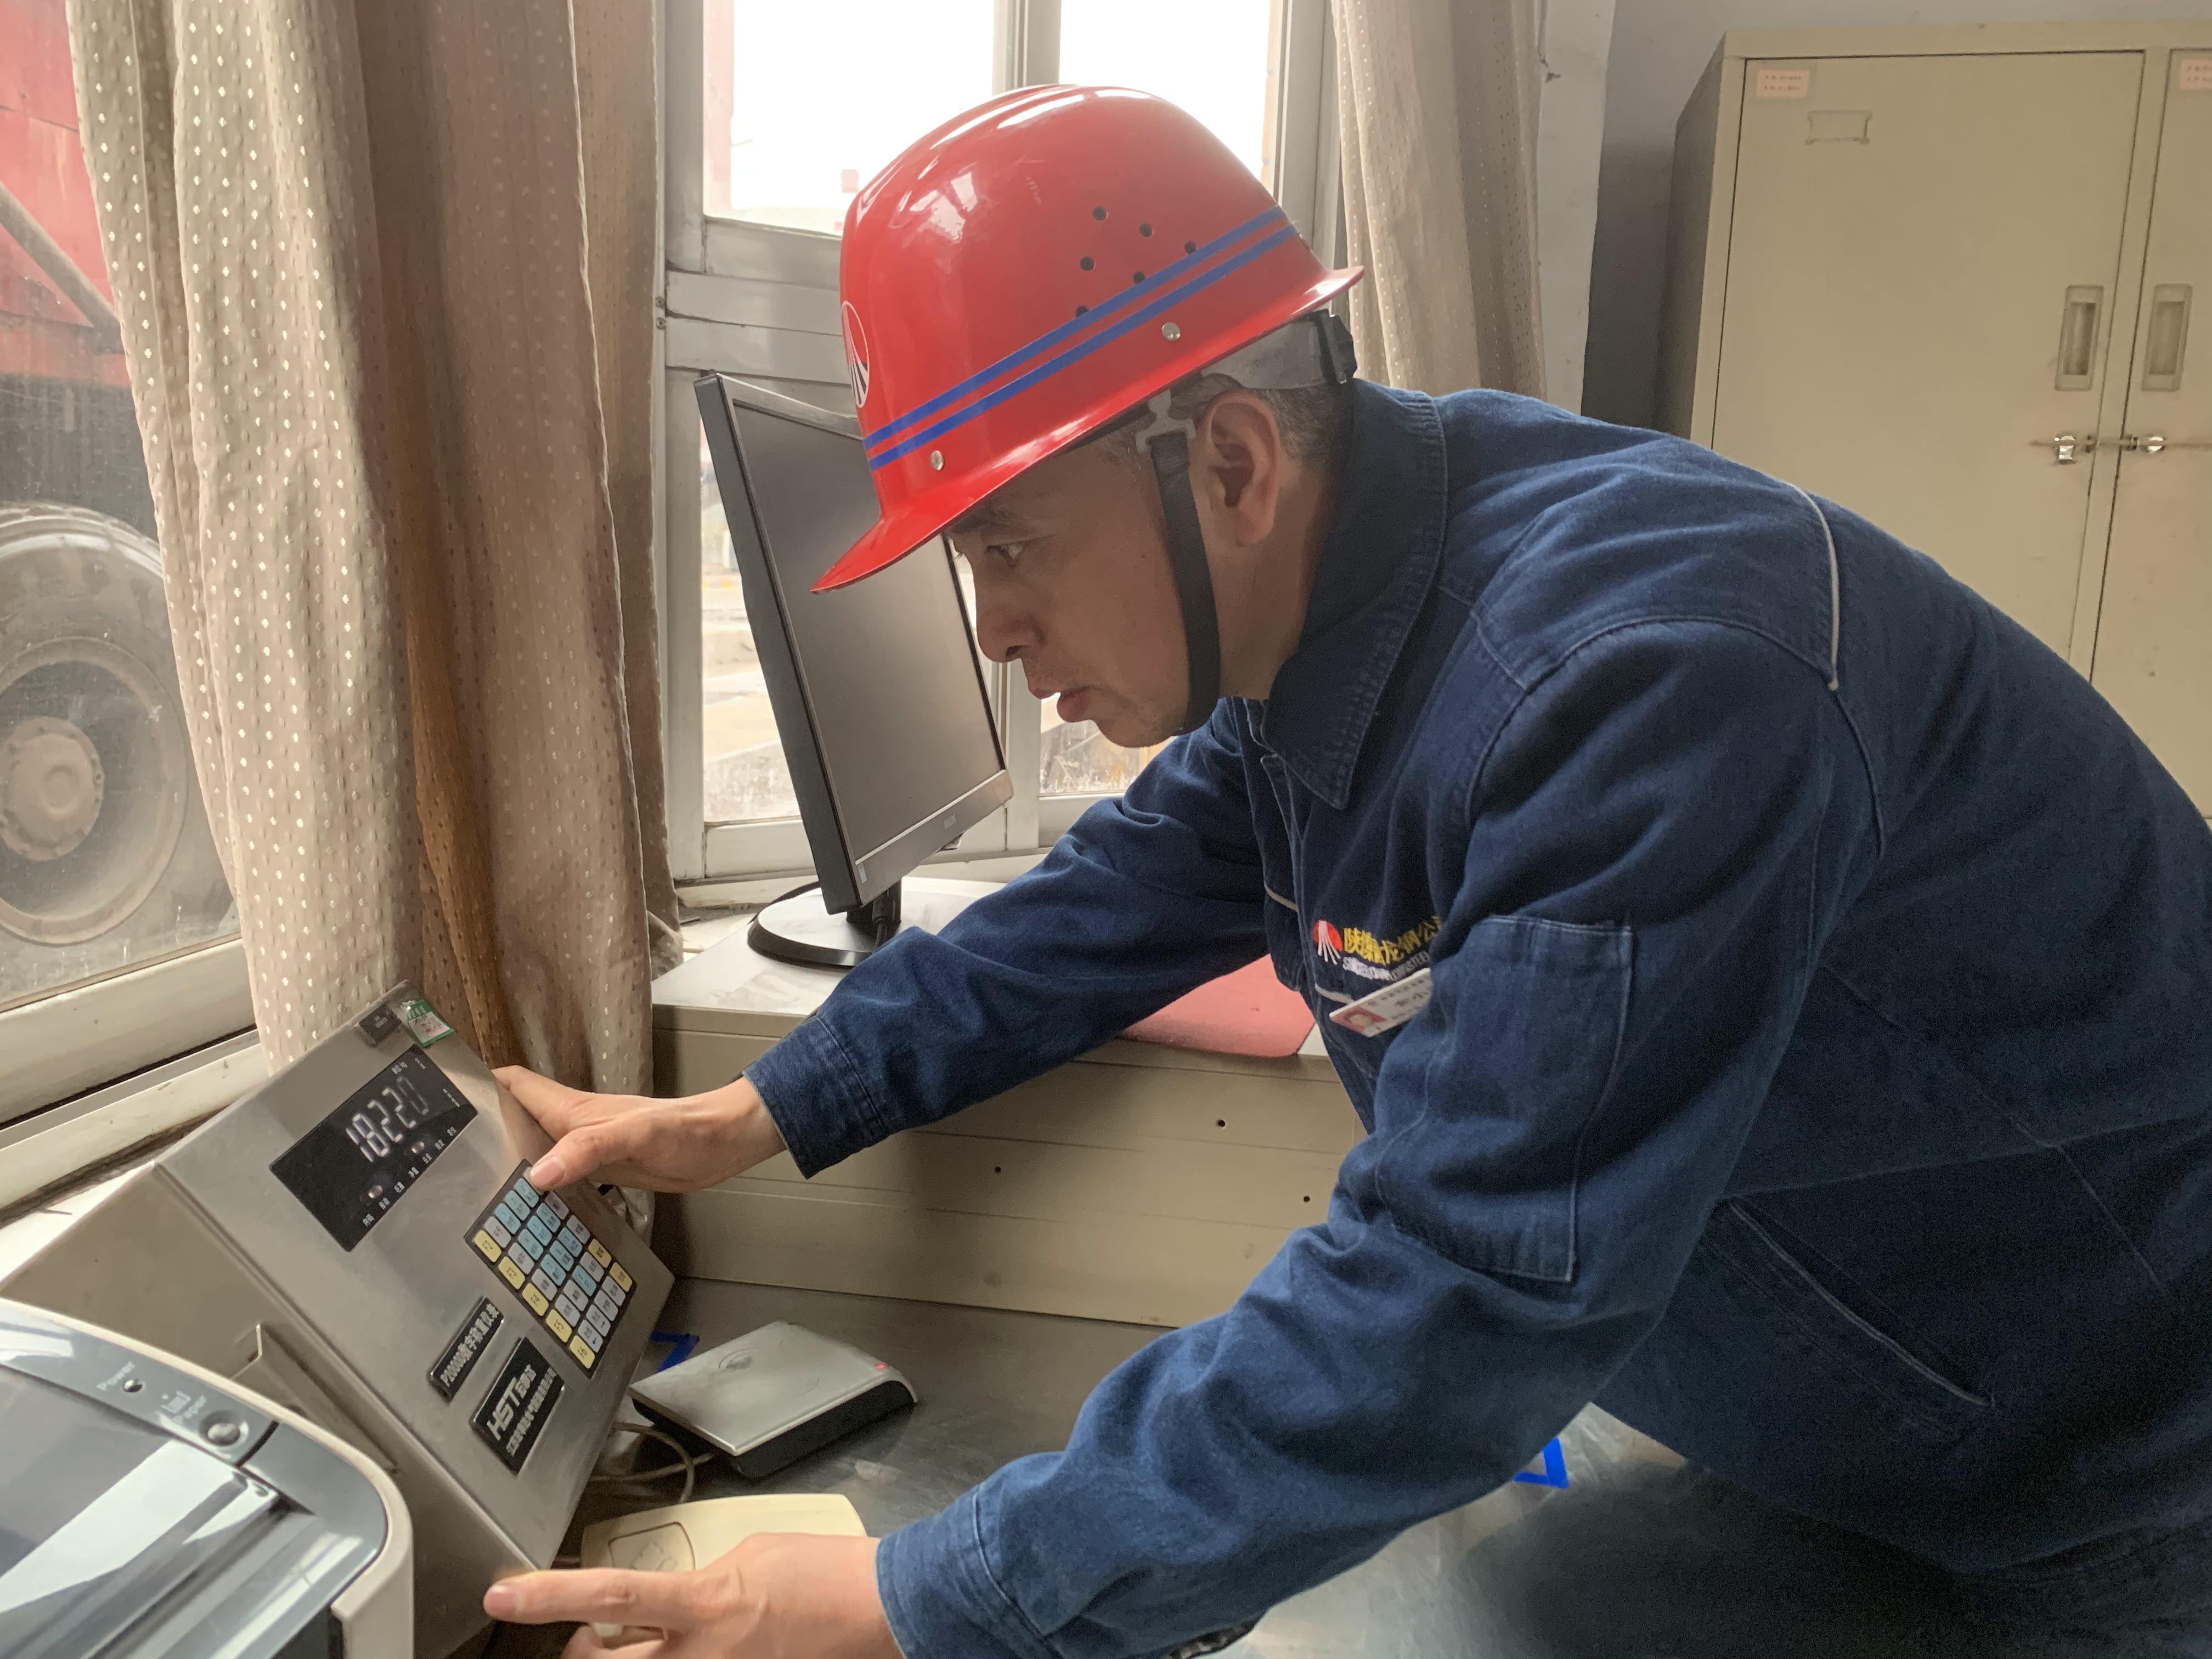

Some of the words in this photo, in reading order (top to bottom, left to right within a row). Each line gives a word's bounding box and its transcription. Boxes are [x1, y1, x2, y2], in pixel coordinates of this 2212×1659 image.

[346, 1076, 429, 1163] 18220
[482, 1240, 493, 1252] F2
[506, 1266, 517, 1279] F3
[531, 1293, 541, 1306] F4
[554, 1319, 565, 1333] F5
[577, 1346, 588, 1359] F6
[97, 1361, 135, 1391] Power
[486, 1376, 520, 1441] HST
